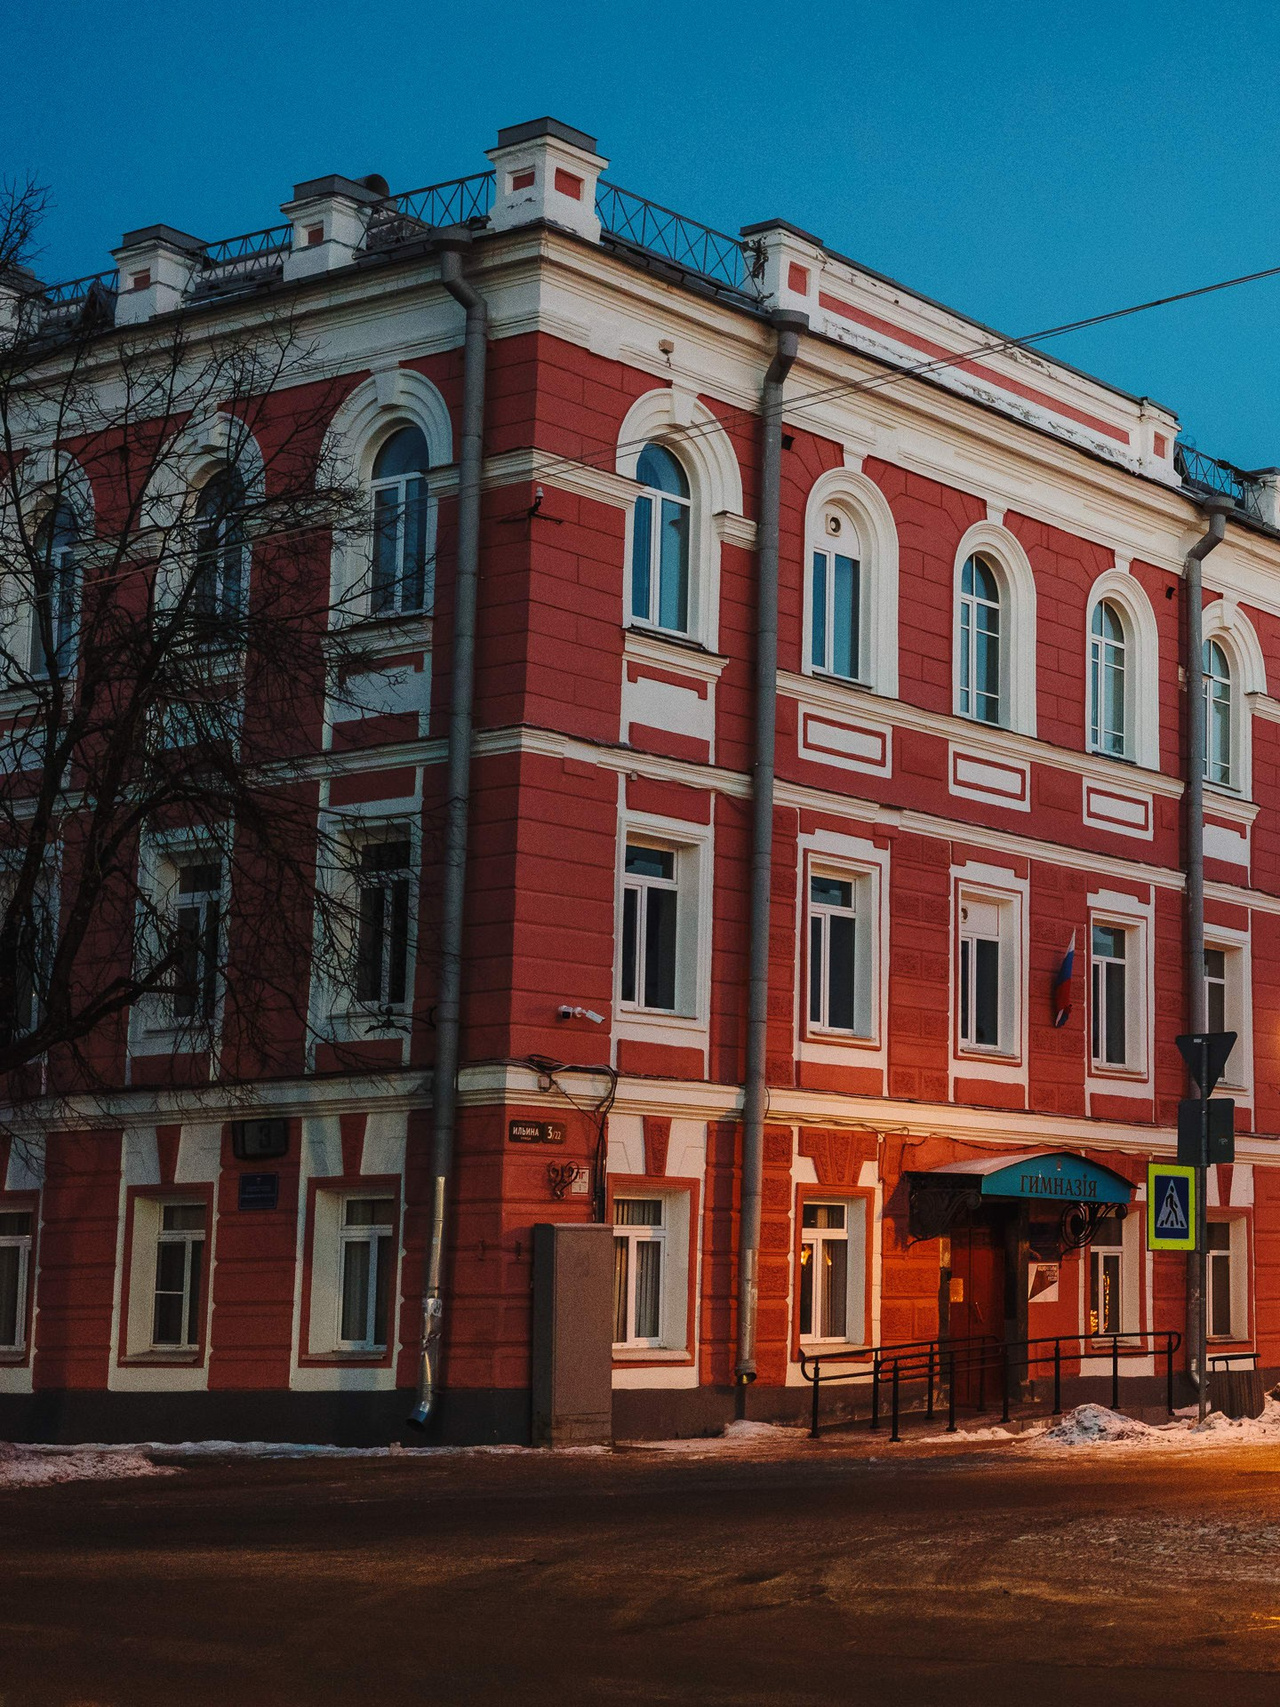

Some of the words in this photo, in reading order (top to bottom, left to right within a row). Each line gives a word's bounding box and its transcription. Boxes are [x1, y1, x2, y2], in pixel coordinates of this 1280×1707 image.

[513, 1127, 539, 1136] ИЛЬИНА
[547, 1126, 561, 1139] 3/22
[1020, 1174, 1096, 1197] ГИМНАЗІЯ
